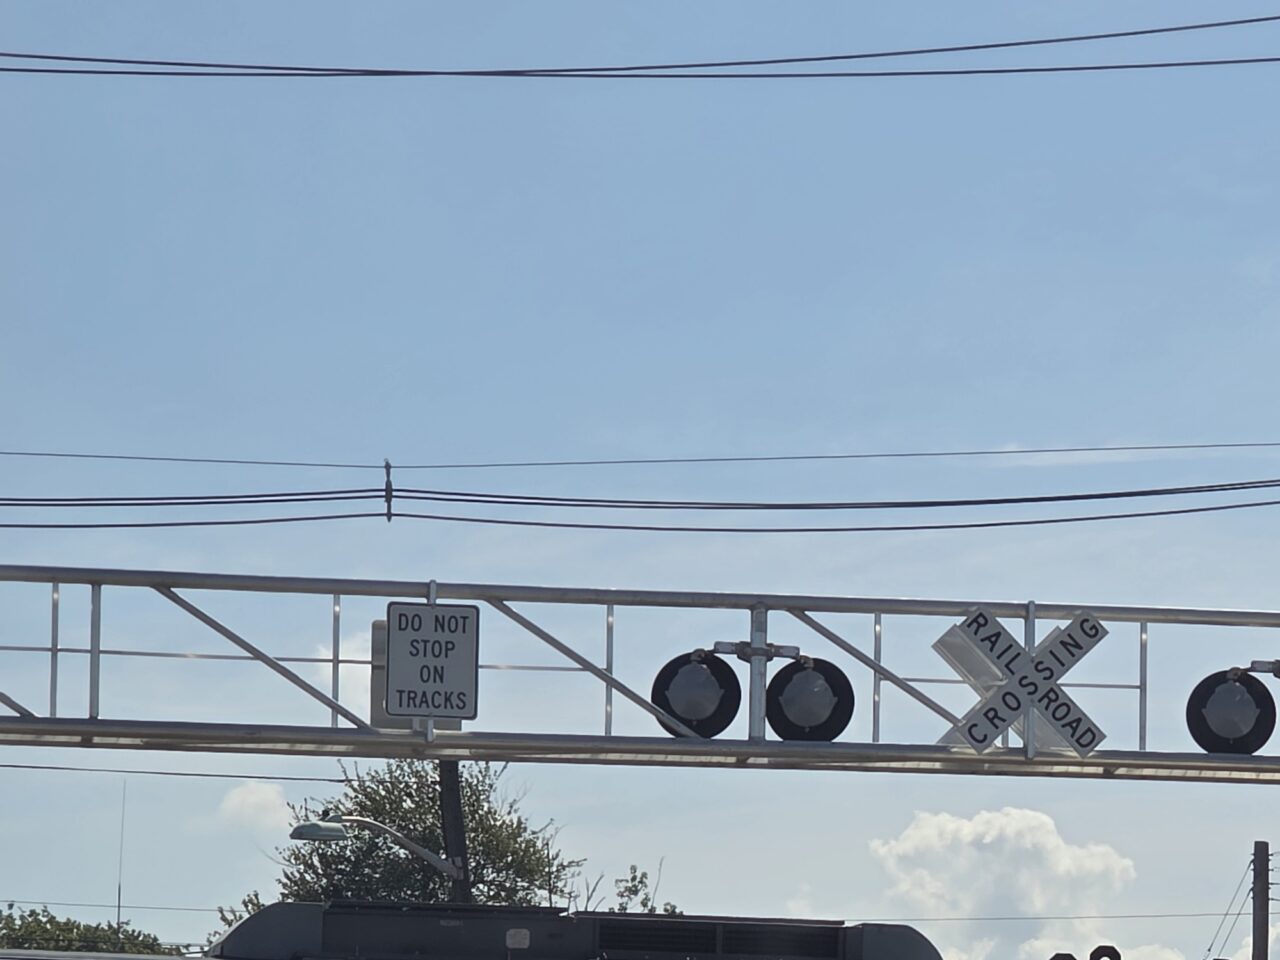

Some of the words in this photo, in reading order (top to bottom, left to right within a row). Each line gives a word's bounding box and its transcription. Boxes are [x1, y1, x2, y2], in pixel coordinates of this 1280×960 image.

[398, 613, 422, 632] DO
[434, 614, 469, 634] NOT
[409, 639, 455, 659] STOP
[420, 665, 444, 683] ON
[967, 618, 1099, 744] CROSSING
[396, 689, 467, 710] TRACKS
